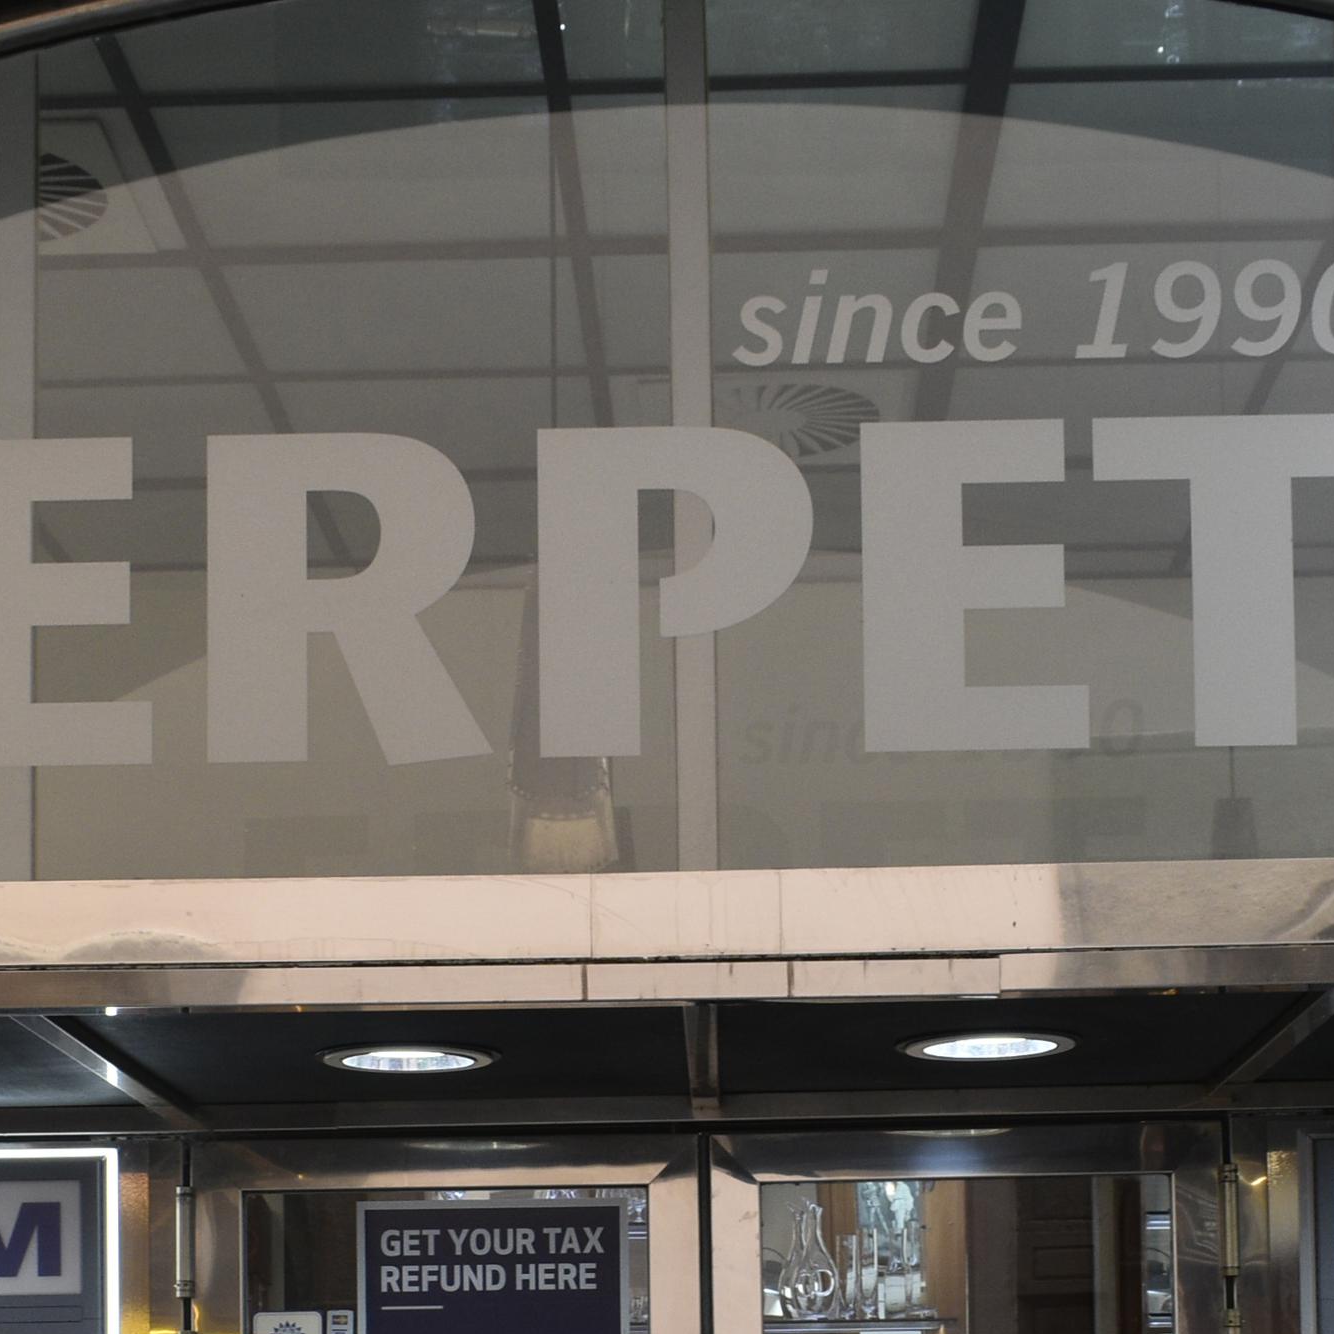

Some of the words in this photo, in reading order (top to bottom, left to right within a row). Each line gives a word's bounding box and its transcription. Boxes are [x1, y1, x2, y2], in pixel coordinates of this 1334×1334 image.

[732, 269, 1022, 367] since
[380, 1229, 441, 1257] GET
[447, 1227, 536, 1256] YOUR
[543, 1227, 605, 1255] TAX
[380, 1264, 506, 1293] REFUND
[515, 1263, 598, 1291] HERE
